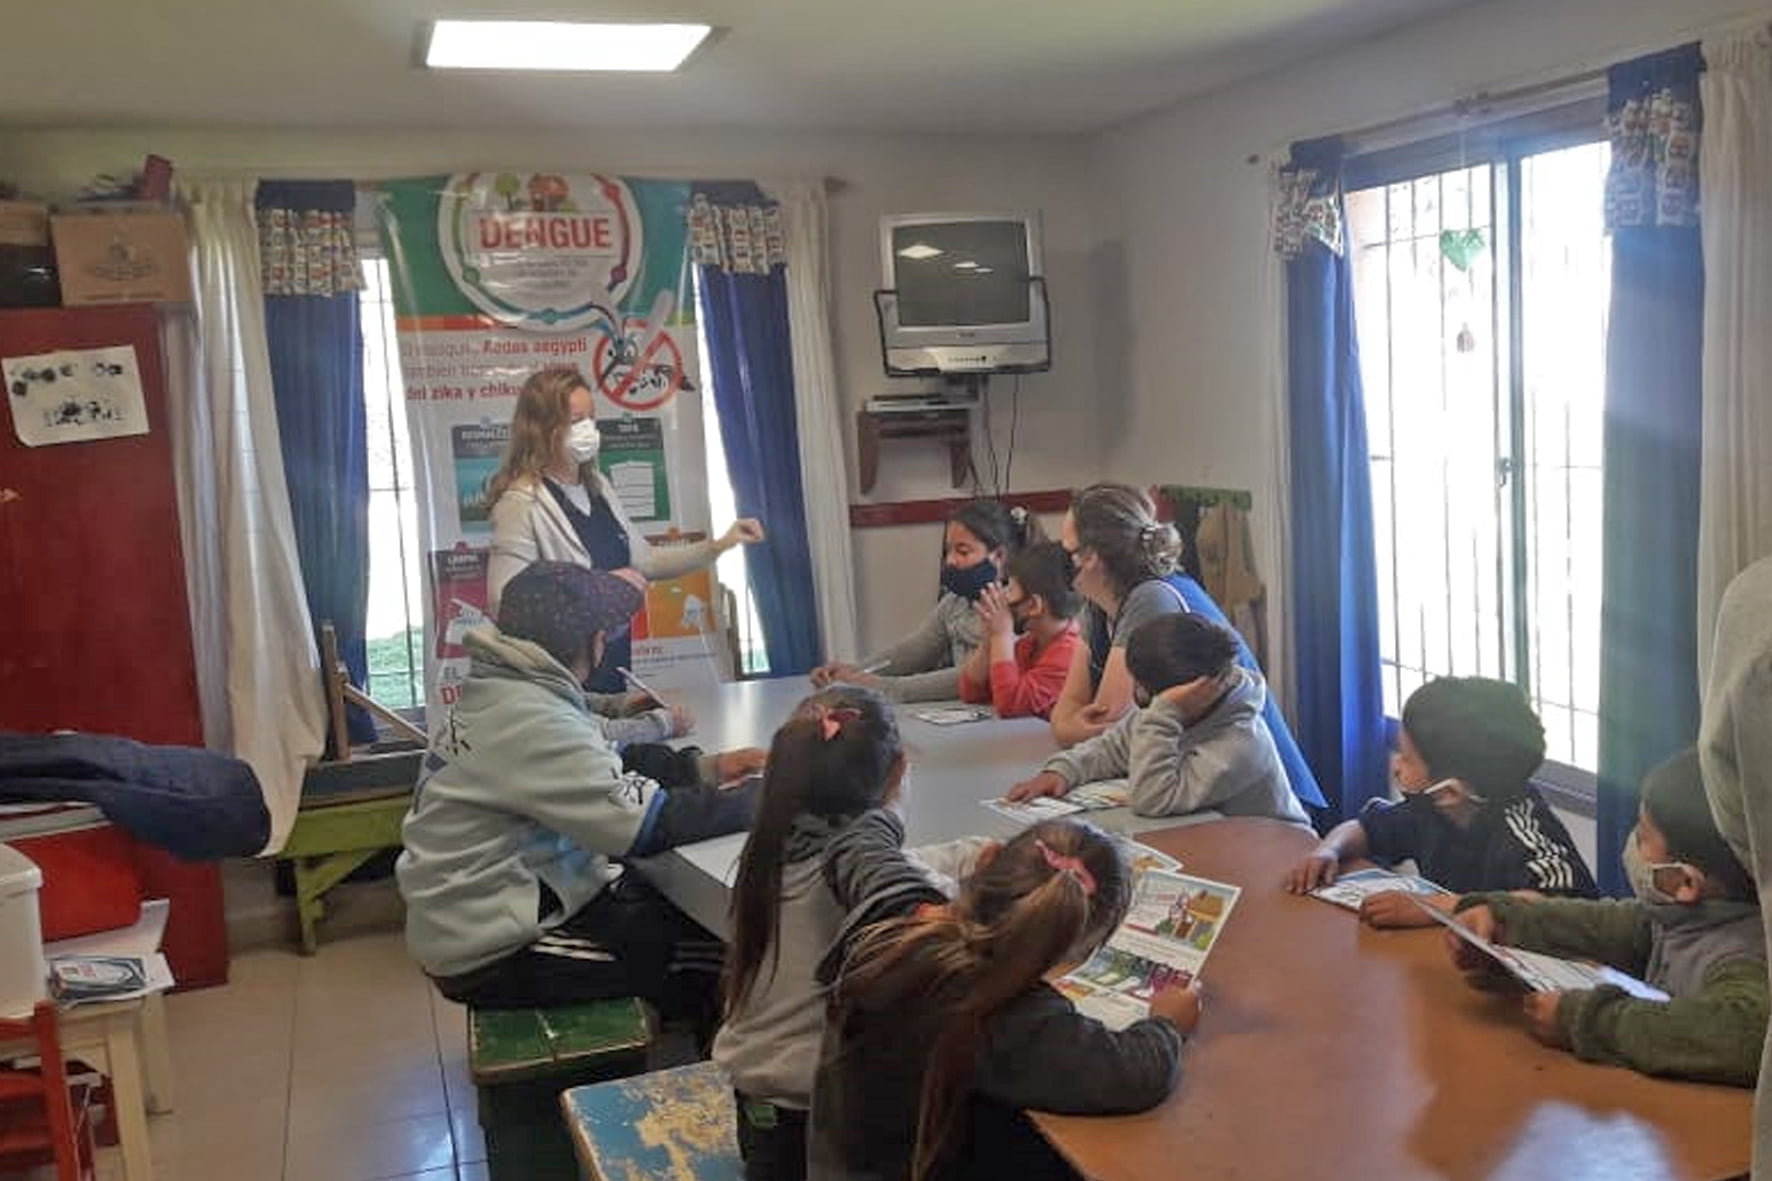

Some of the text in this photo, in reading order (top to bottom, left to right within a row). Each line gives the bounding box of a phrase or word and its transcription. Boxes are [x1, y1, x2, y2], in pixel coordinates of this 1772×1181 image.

[478, 217, 612, 249] DENGUE
[533, 337, 588, 357] aegypti
[431, 384, 464, 400] zika
[479, 381, 524, 398] chiku
